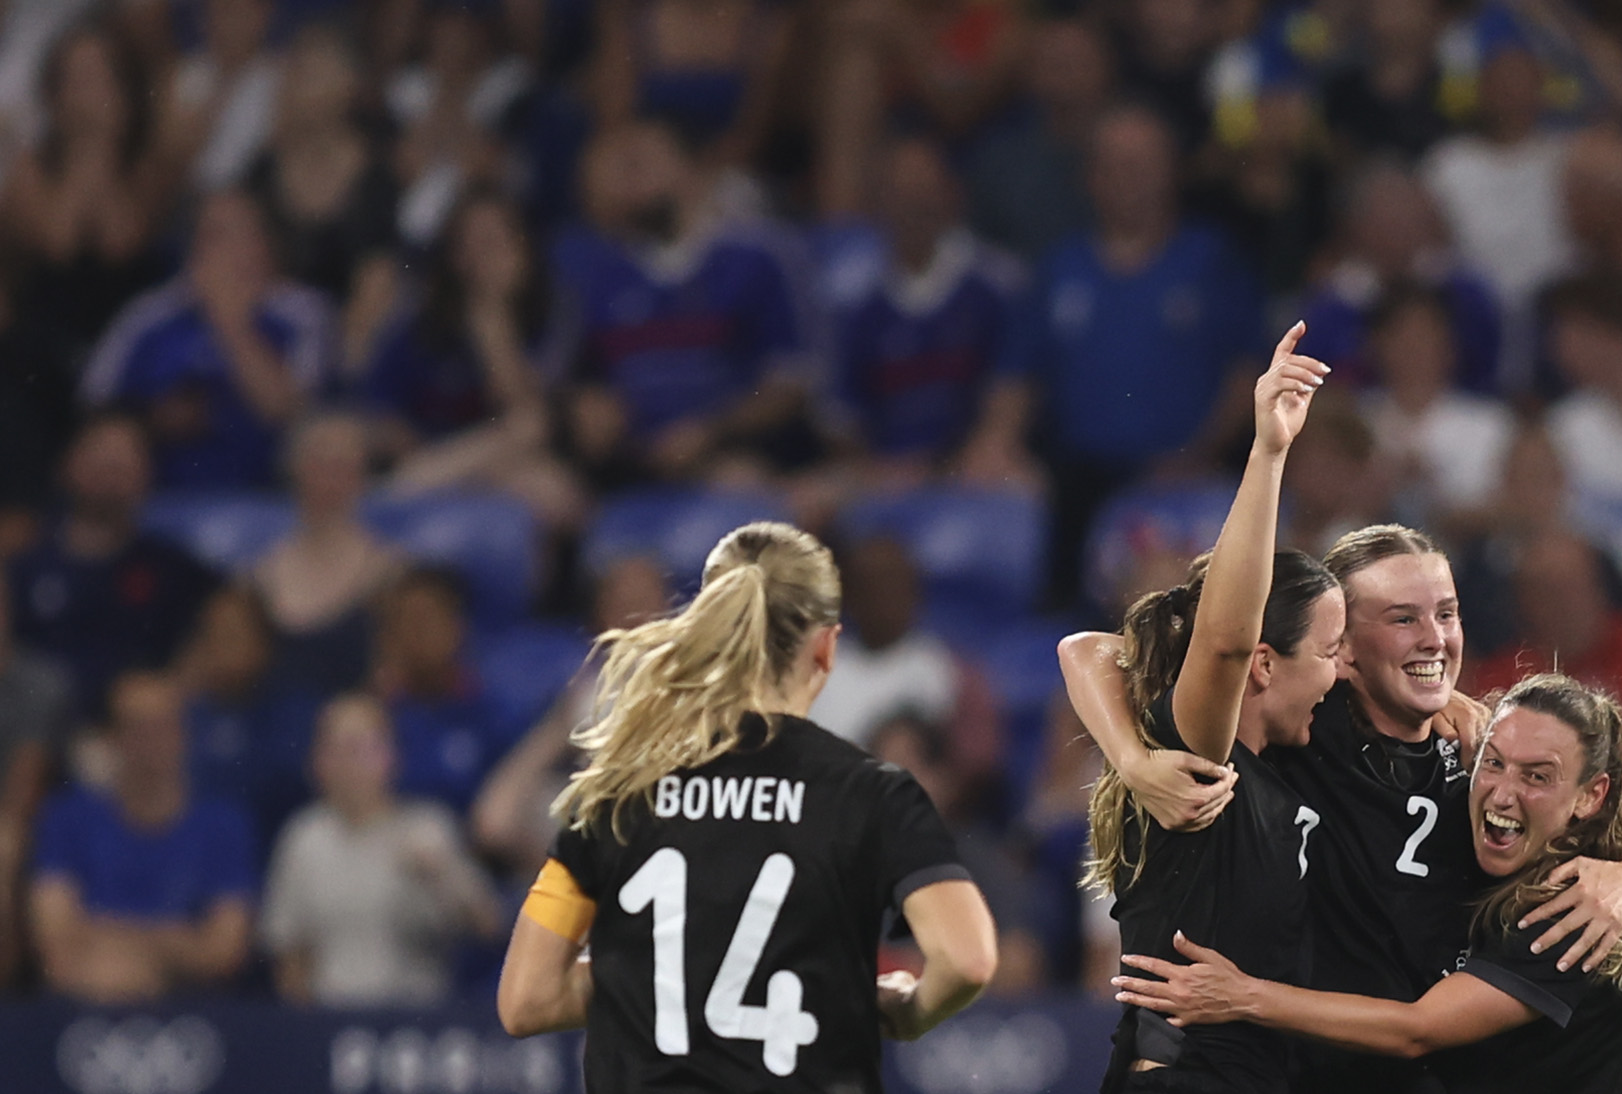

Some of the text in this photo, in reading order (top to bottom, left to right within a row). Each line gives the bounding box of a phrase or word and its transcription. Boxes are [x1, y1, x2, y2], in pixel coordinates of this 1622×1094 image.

[655, 775, 805, 824] BOWEN
[1395, 795, 1439, 878] 2
[618, 847, 819, 1077] 14
